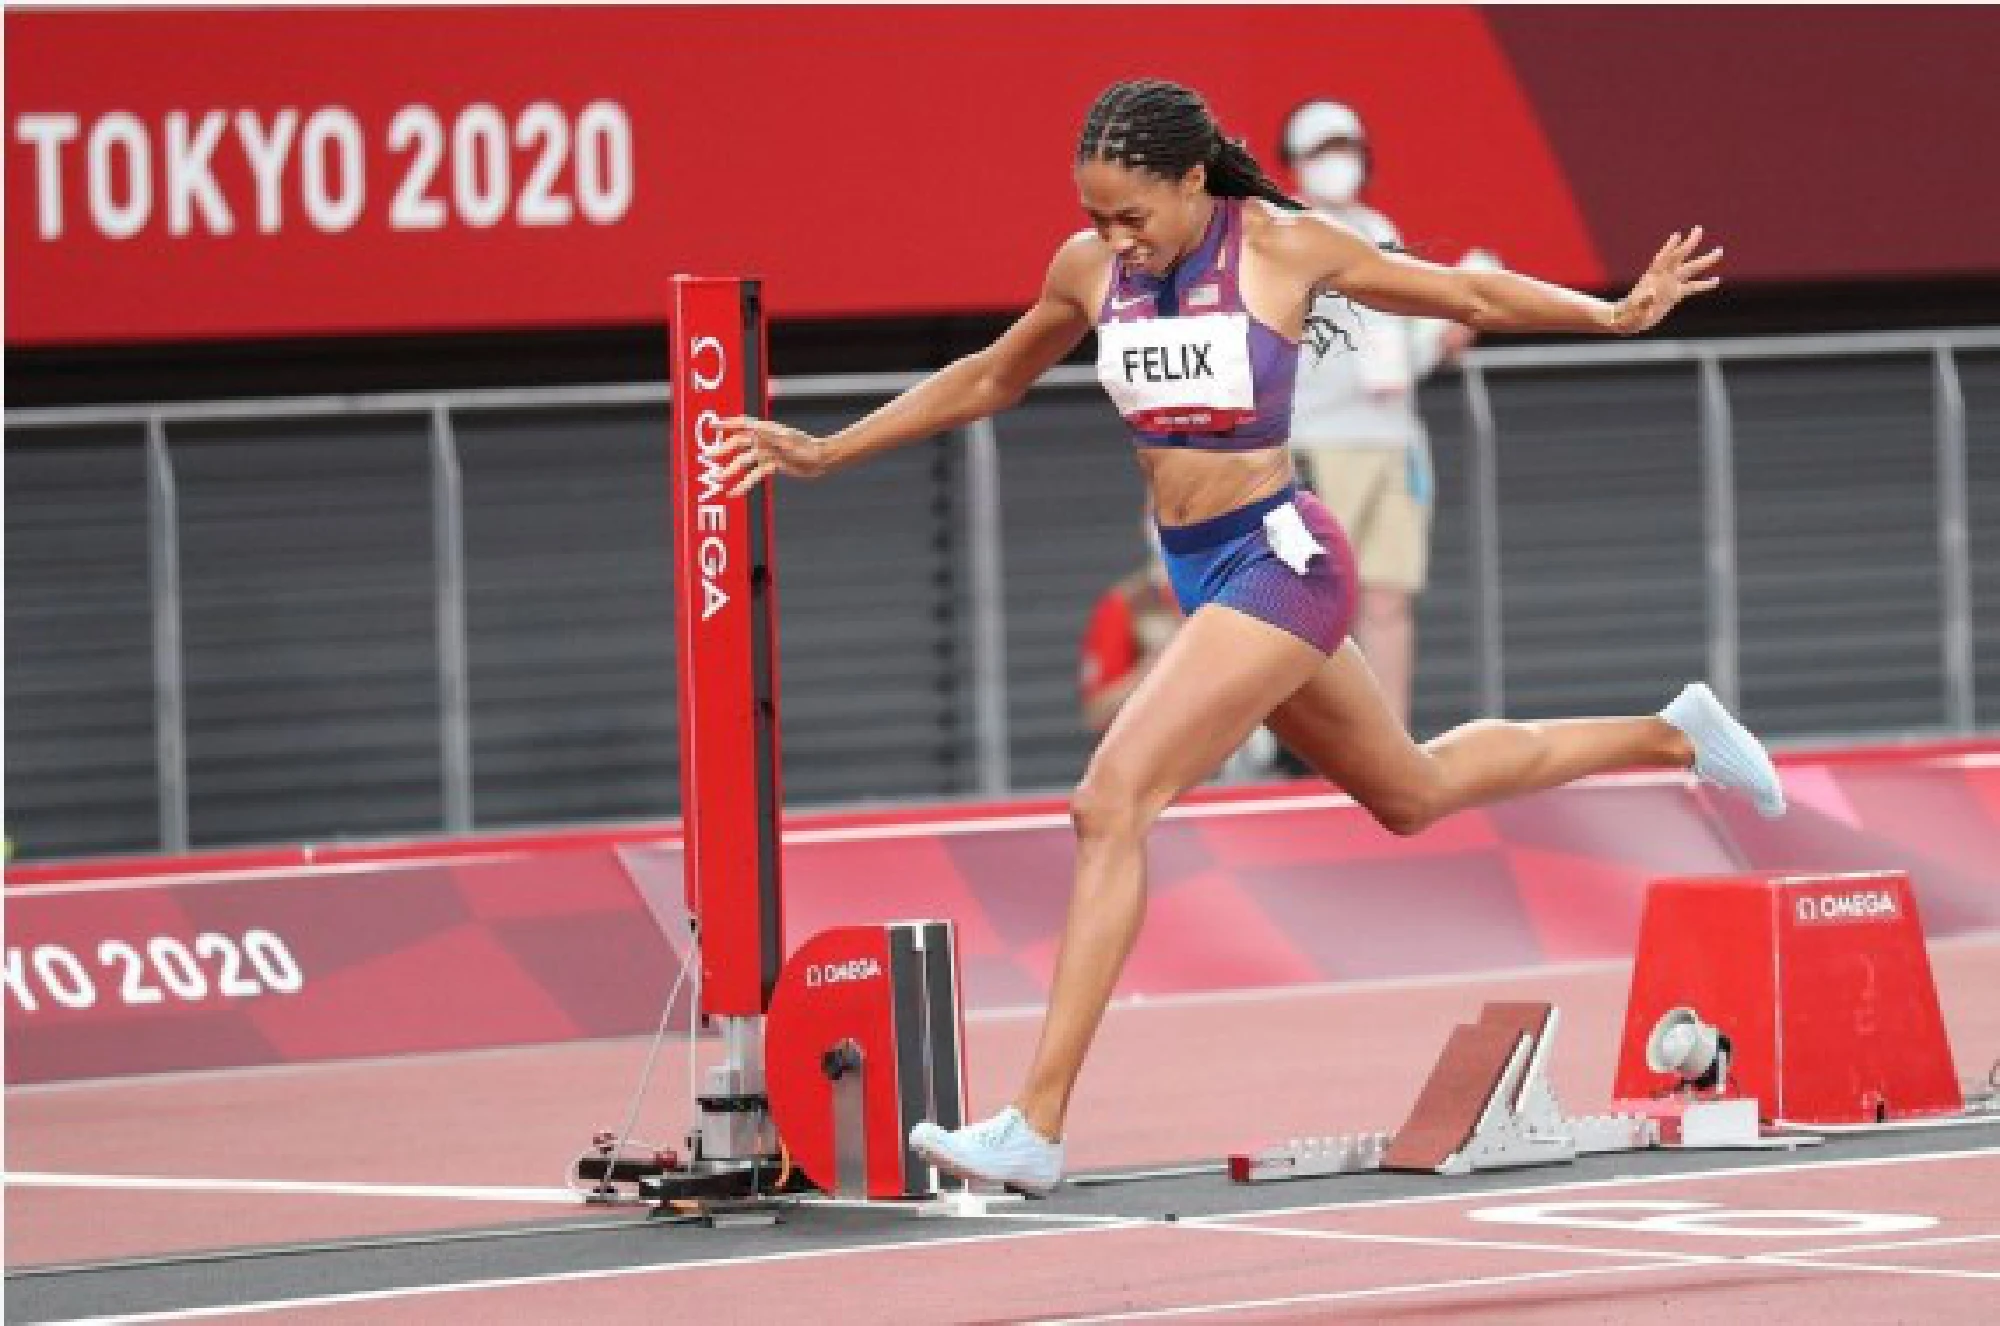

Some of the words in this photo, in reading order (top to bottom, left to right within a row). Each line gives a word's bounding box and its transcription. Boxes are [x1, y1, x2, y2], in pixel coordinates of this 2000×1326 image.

[16, 107, 367, 241] TOKYO
[386, 101, 634, 234] 2020
[1122, 341, 1214, 382] FELIX
[1820, 890, 1896, 917] OMEGA
[97, 928, 304, 1004] 2020
